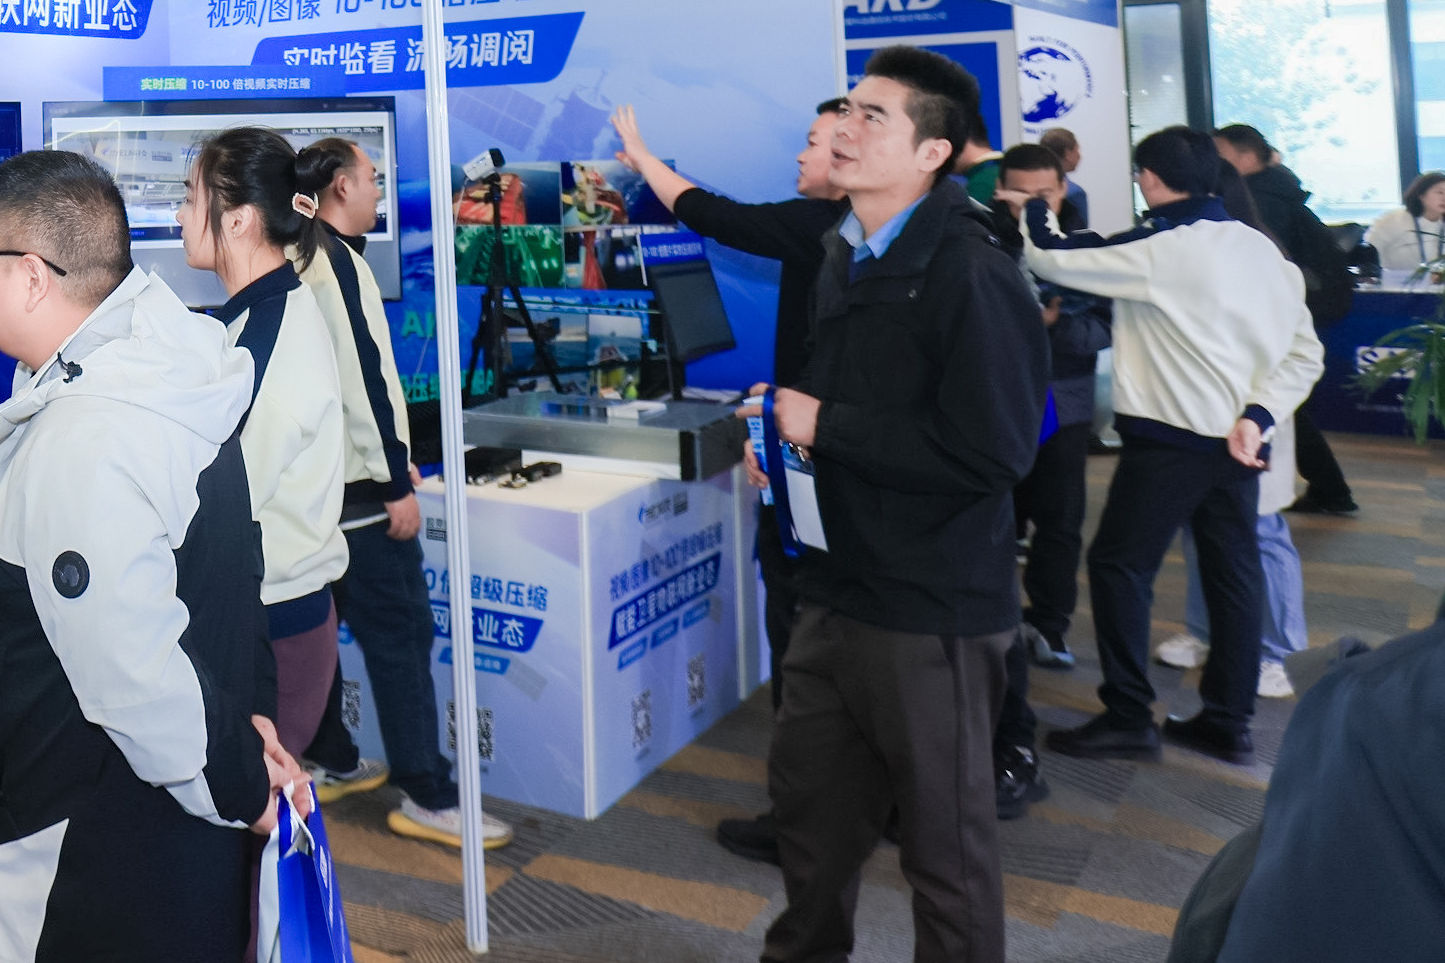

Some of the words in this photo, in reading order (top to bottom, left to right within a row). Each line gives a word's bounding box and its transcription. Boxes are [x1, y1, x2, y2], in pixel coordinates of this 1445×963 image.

[283, 40, 397, 75] 实时监看
[140, 77, 188, 91] 实时压缩
[191, 79, 230, 90] 10-100
[232, 77, 311, 91] 倍视频实时压缩
